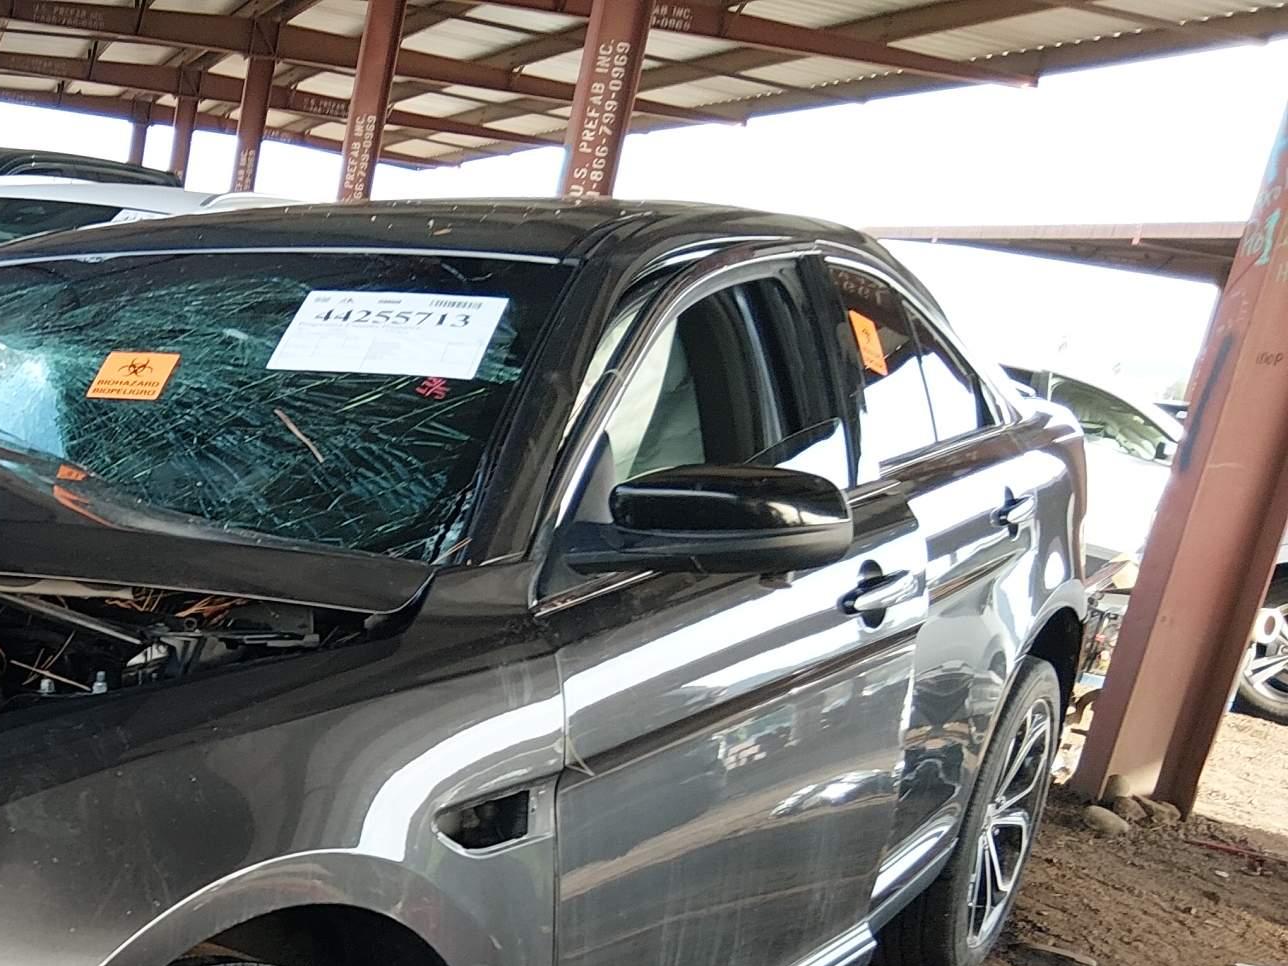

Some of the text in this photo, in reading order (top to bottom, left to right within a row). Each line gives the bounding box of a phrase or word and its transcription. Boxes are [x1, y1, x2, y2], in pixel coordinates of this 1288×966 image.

[579, 83, 605, 153] PREFAB
[595, 39, 615, 74] INC.
[585, 41, 632, 199] 1-866-799-0969
[344, 142, 361, 189] PREFAB
[353, 114, 377, 199] 66-799-0969
[314, 306, 472, 329] 44255713
[97, 379, 159, 387] BIOHAZARD
